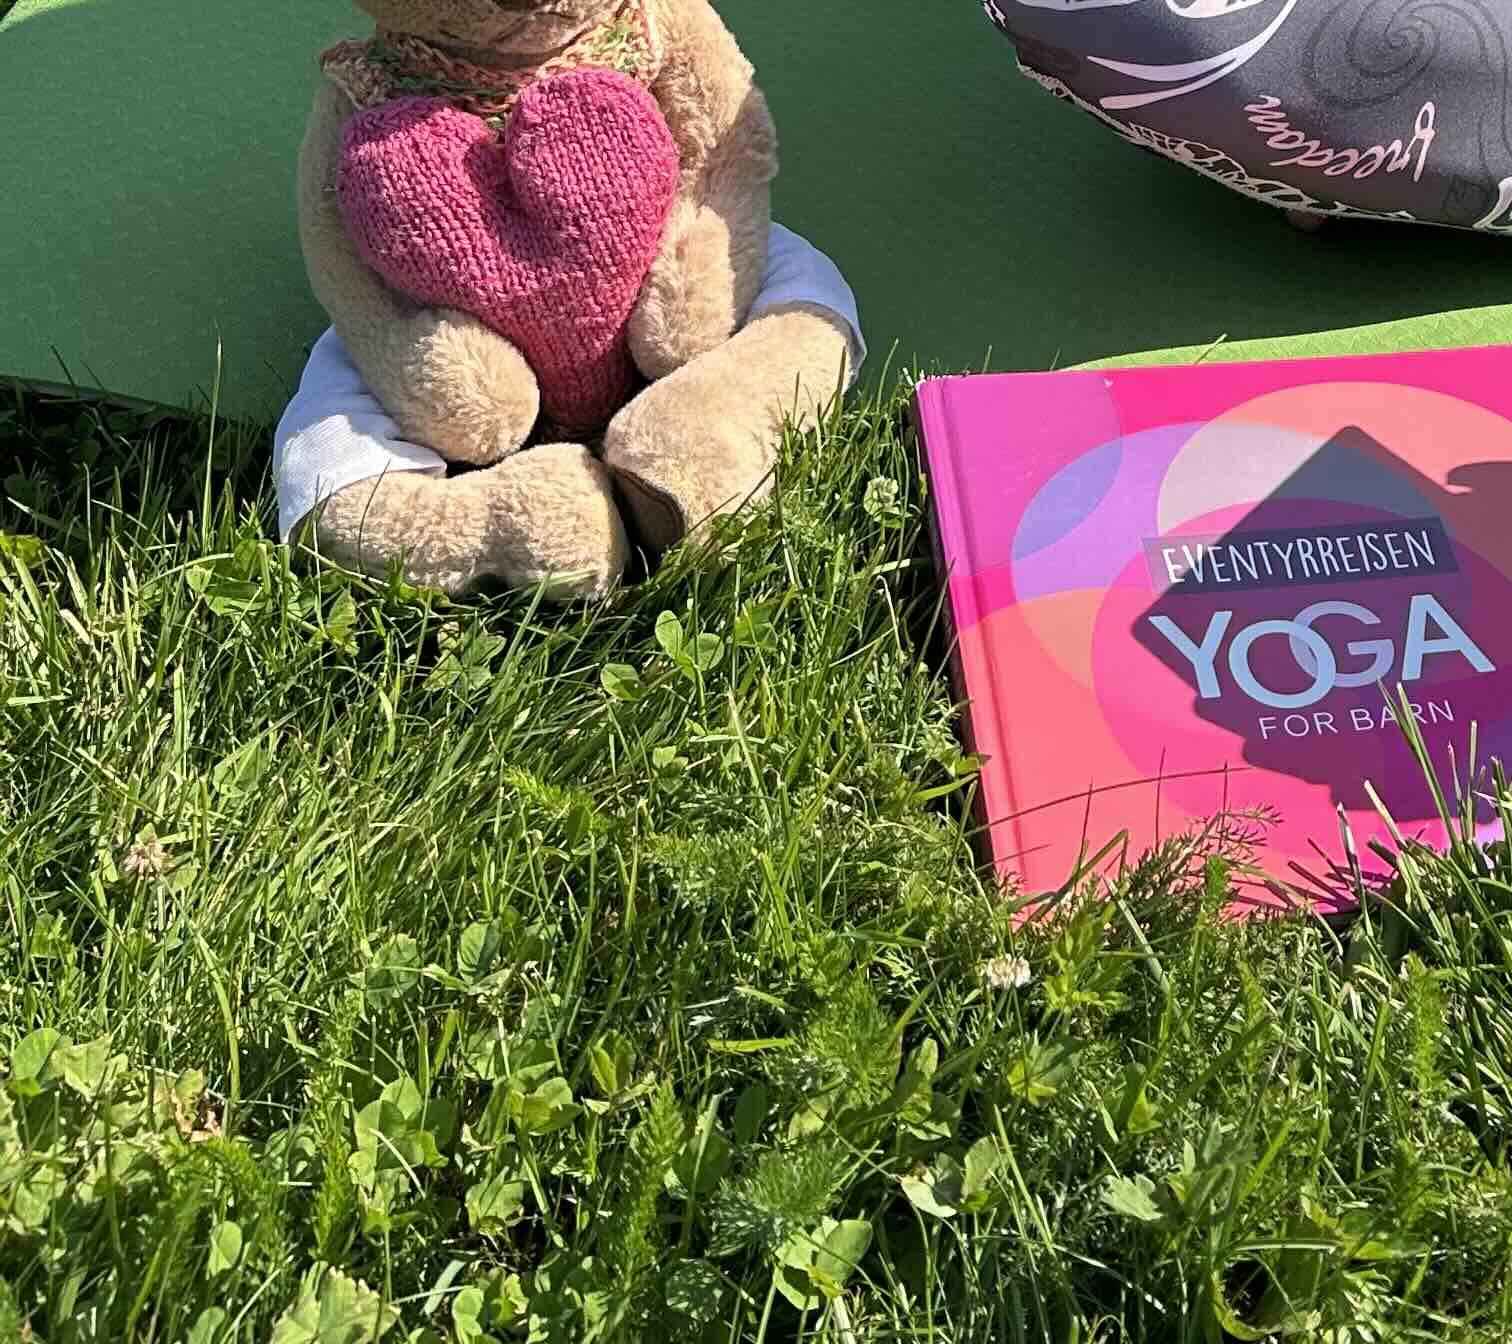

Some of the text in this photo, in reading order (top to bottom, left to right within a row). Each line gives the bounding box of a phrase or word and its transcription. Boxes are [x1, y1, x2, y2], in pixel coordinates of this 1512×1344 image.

[1161, 529, 1436, 584] EVENTYRREISEN
[1148, 593, 1496, 709] YOGA
[1258, 699, 1454, 741] FOR BARN
